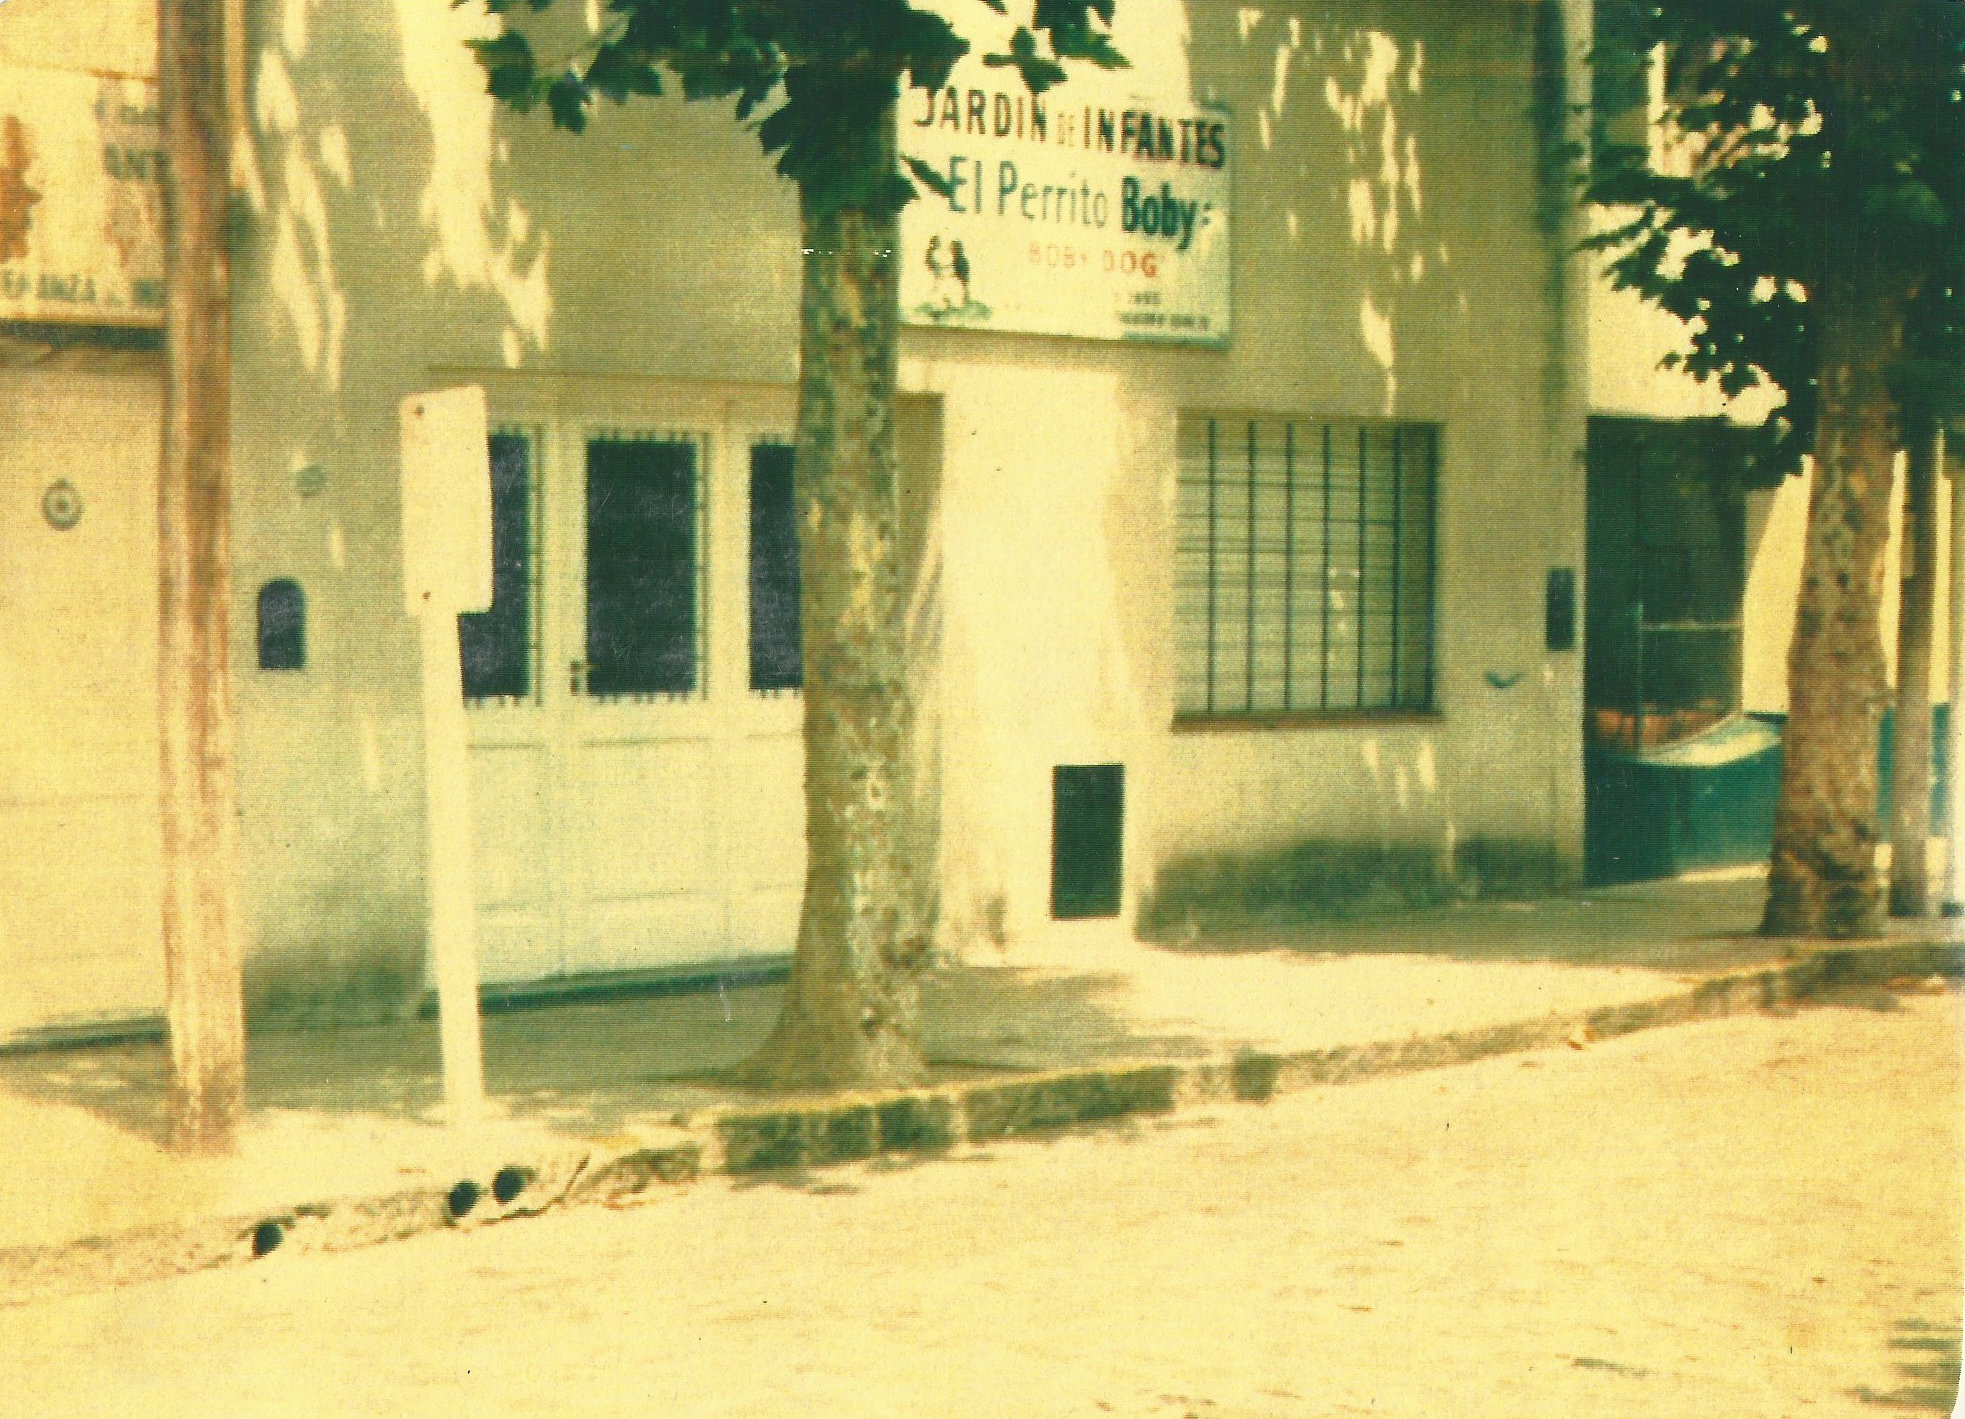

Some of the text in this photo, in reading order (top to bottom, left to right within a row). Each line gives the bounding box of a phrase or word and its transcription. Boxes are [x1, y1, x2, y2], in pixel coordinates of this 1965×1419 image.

[1082, 103, 1227, 170] INFANTES
[948, 155, 983, 215] El
[997, 159, 1109, 230] Perrito
[1102, 249, 1159, 279] DOG
